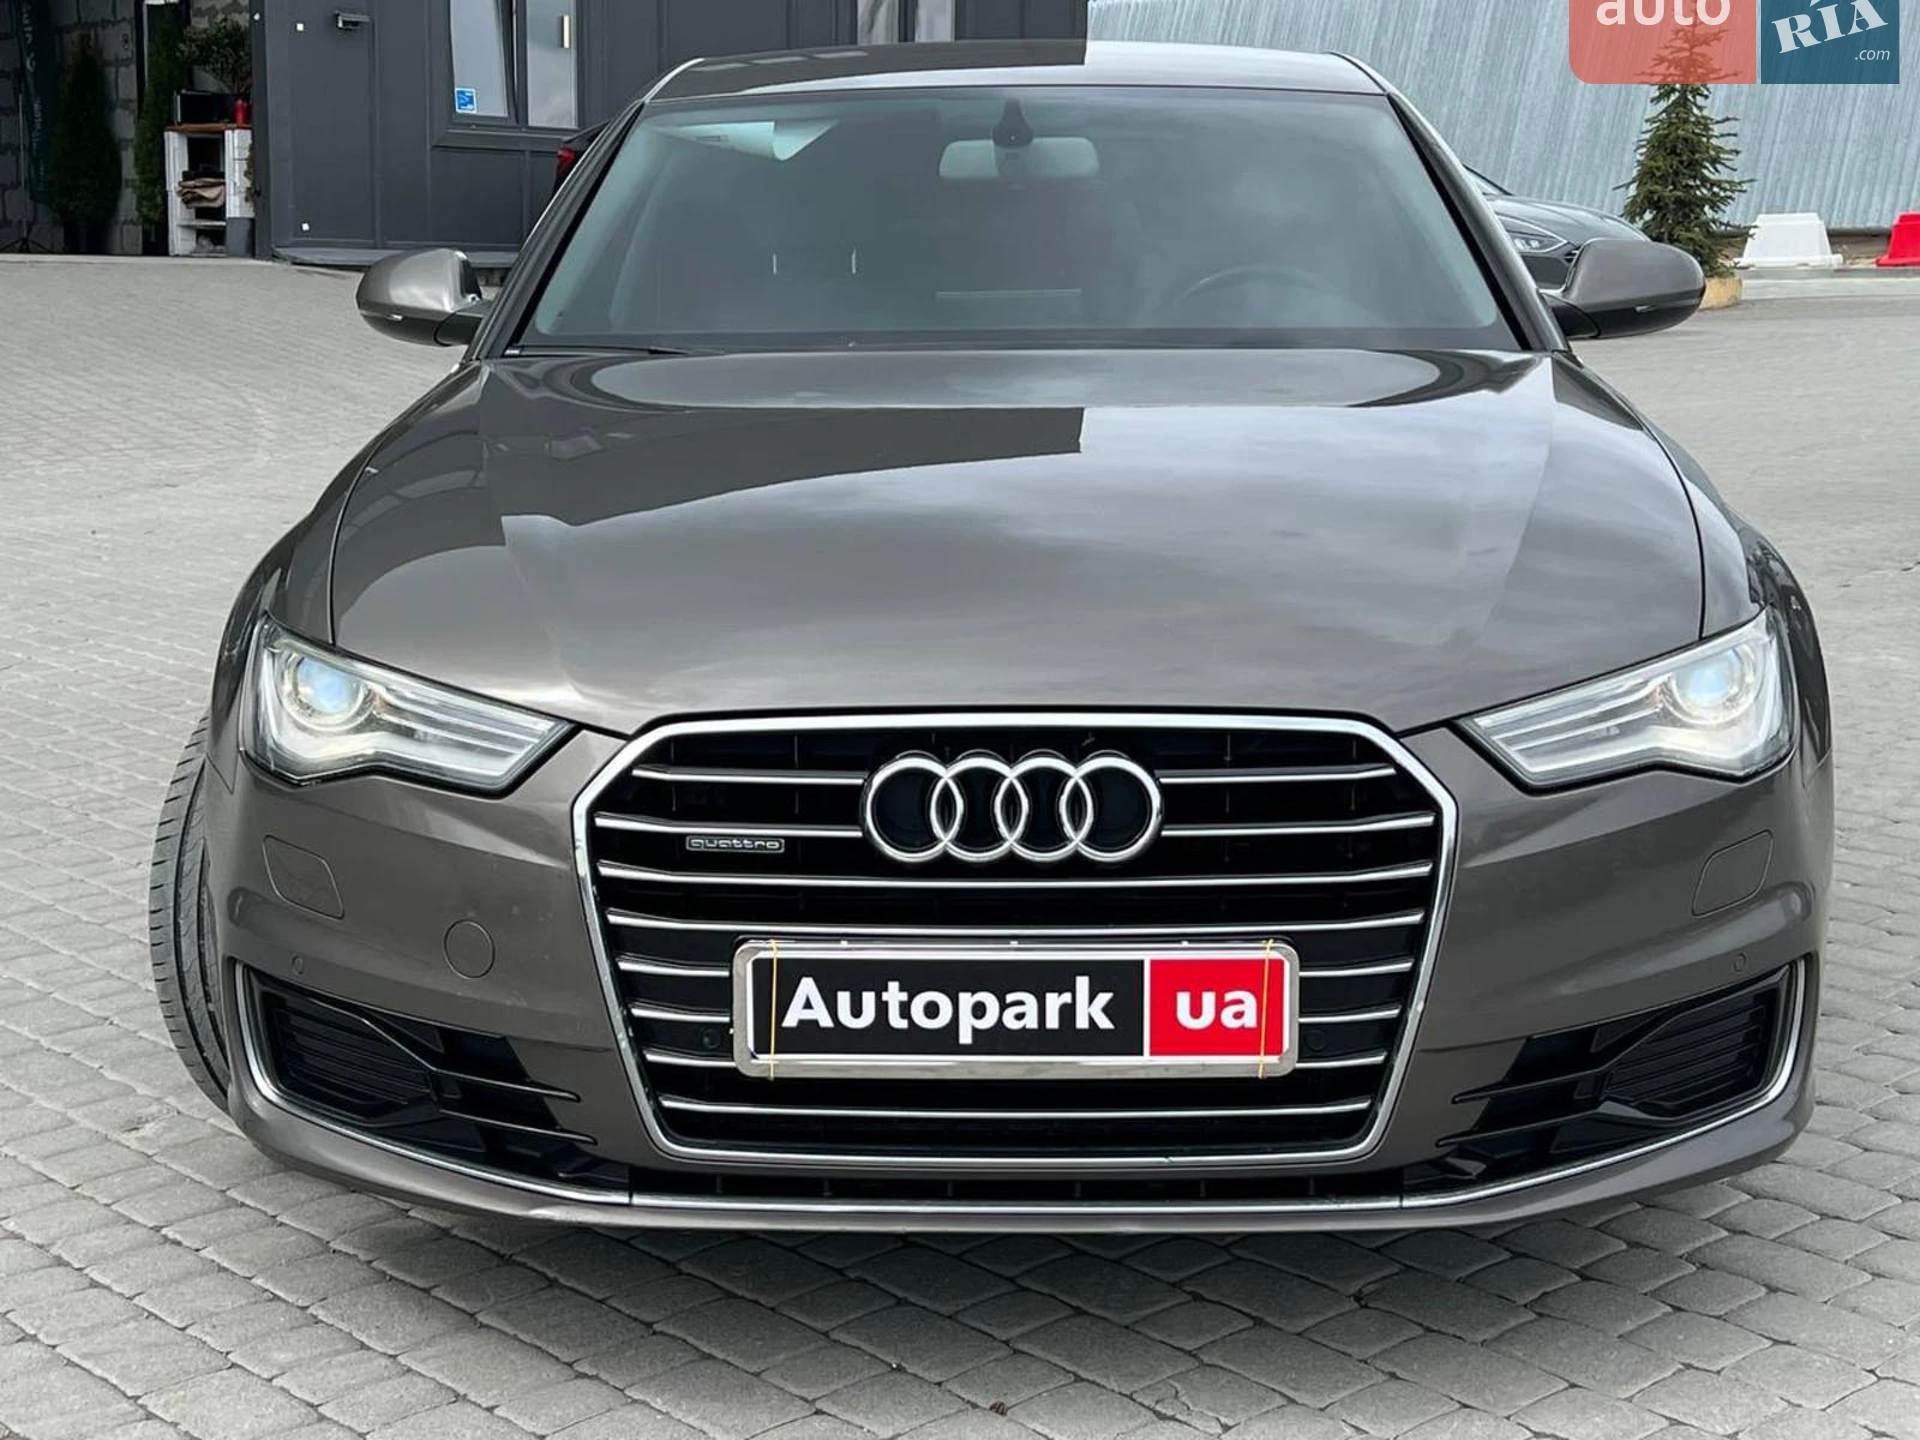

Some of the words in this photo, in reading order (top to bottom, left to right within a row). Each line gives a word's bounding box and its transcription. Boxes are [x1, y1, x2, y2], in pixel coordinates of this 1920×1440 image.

[690, 838, 780, 850] quattro
[781, 975, 1115, 1044] Autopark
[1175, 990, 1258, 1030] ua
